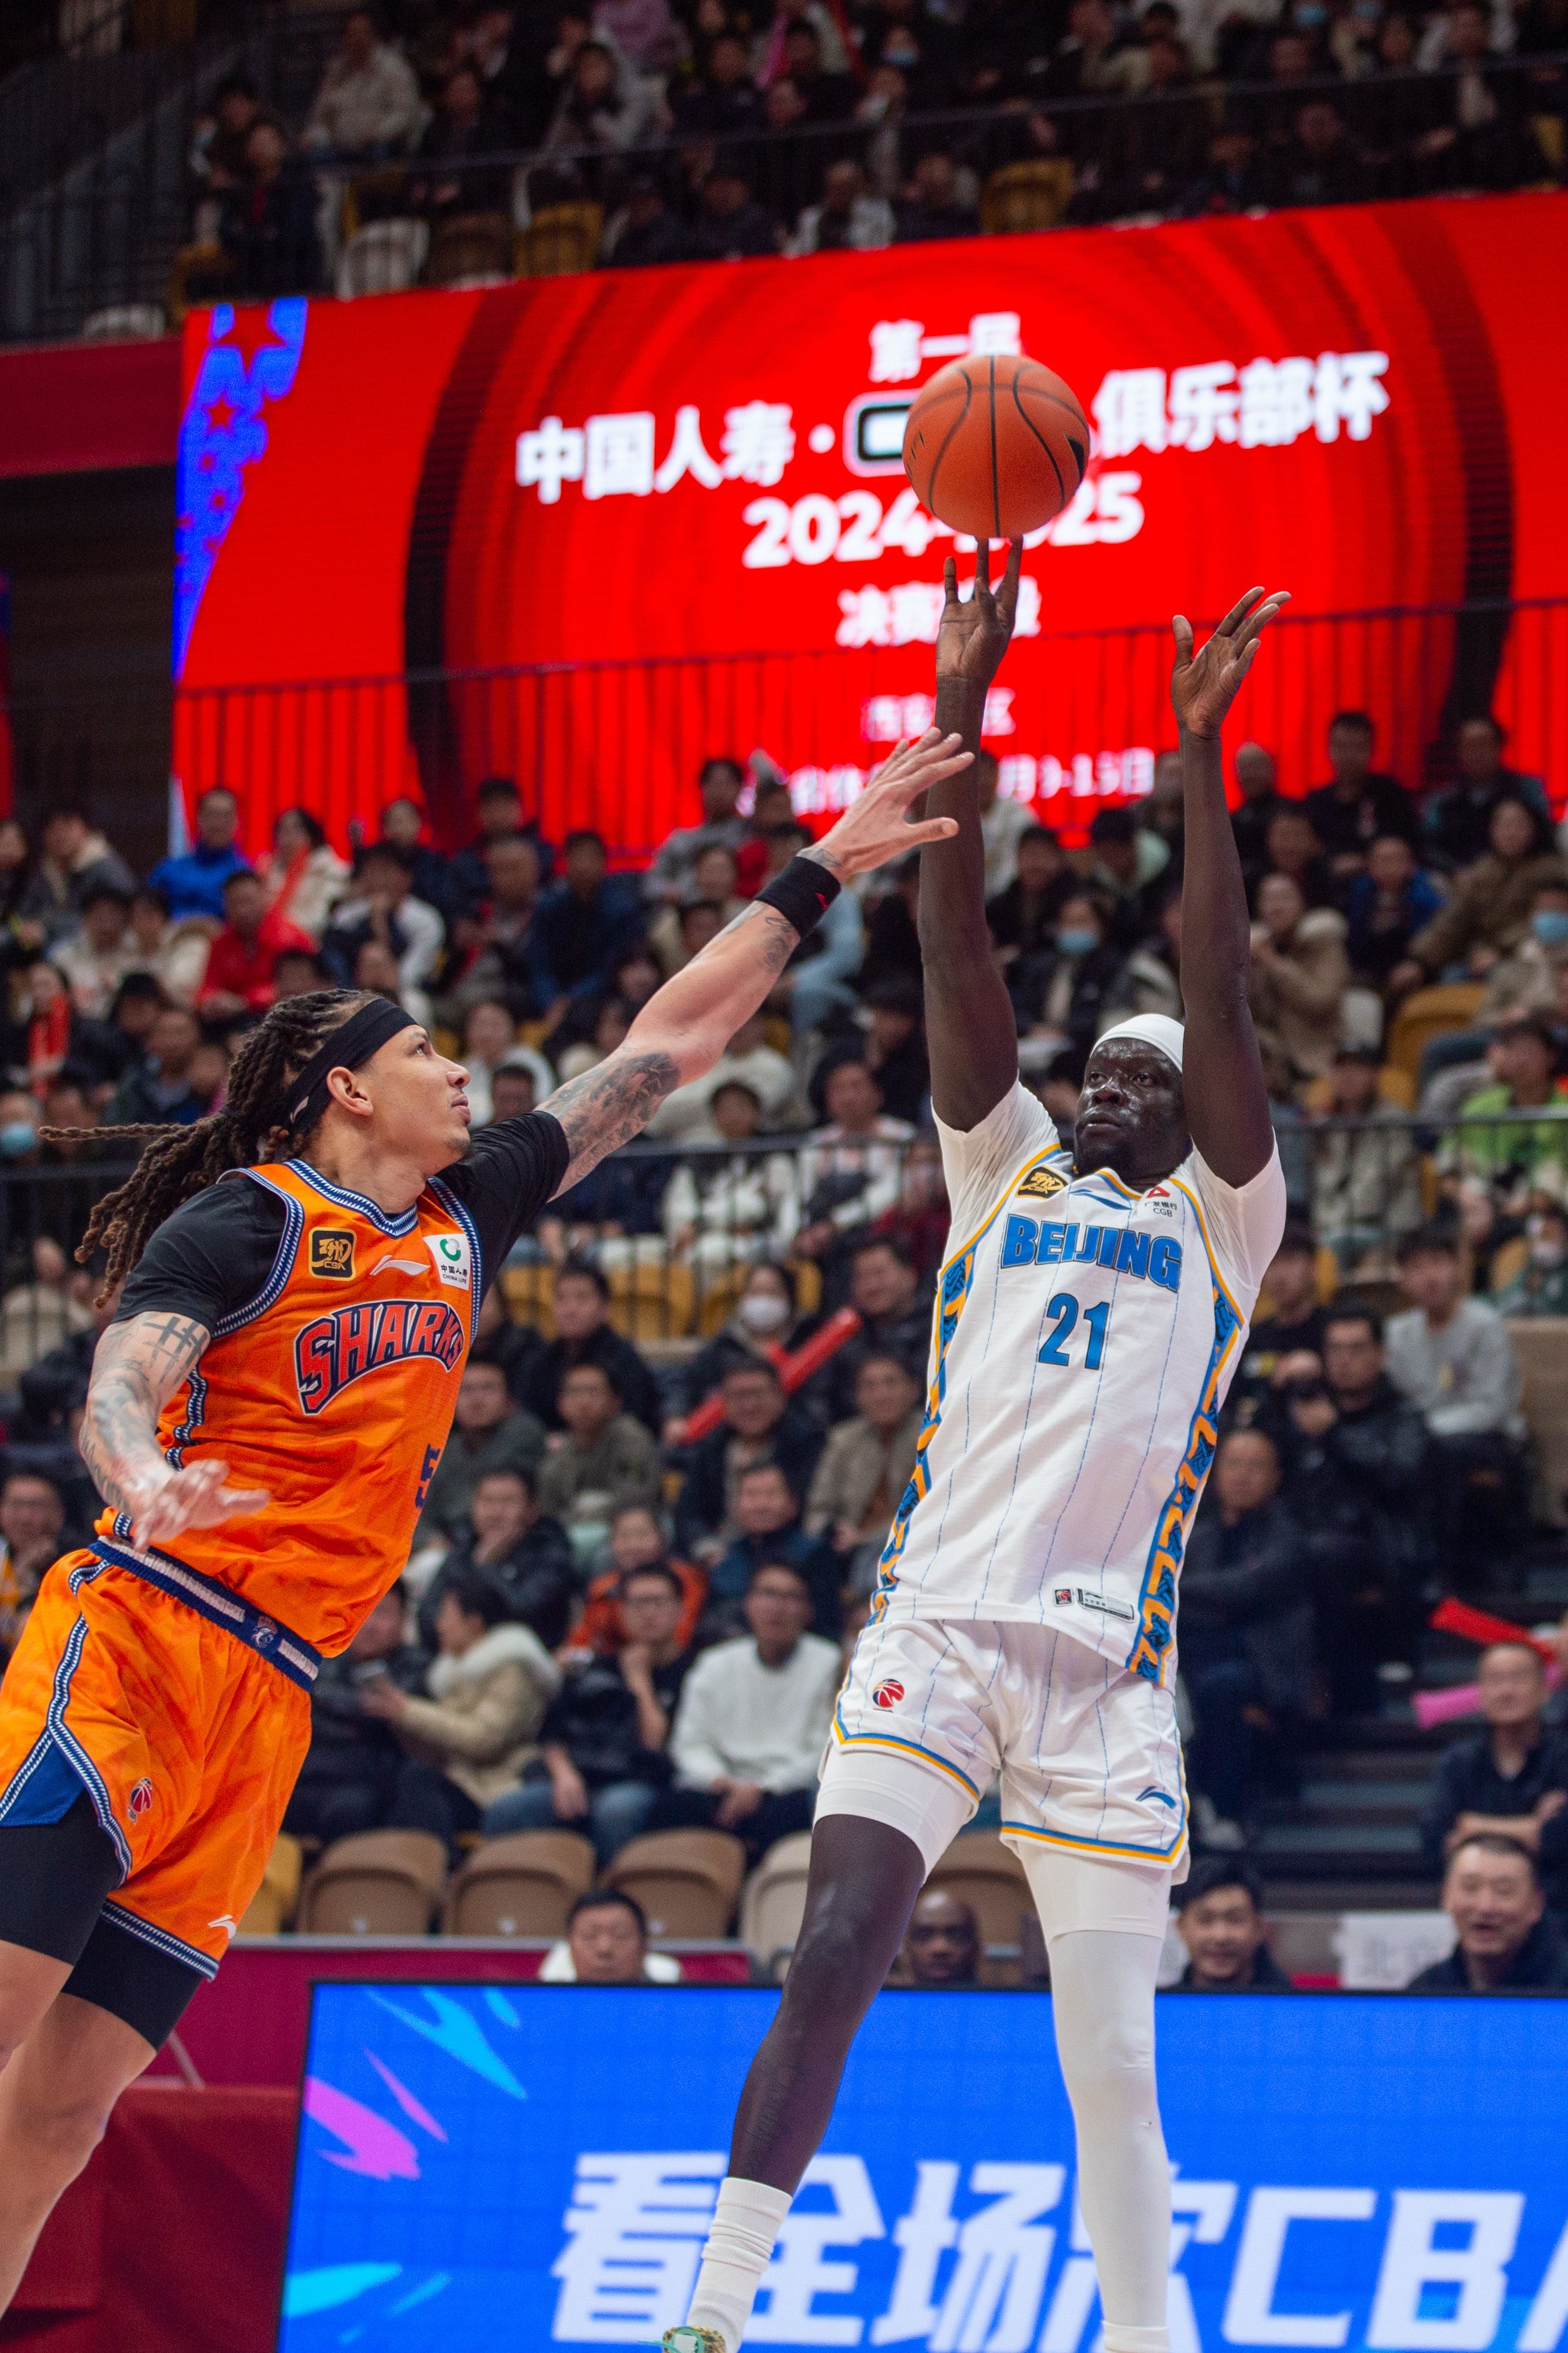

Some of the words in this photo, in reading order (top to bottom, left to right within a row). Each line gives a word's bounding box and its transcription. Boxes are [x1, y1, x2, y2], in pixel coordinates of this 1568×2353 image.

[742, 471, 1145, 570] 2024-25
[1153, 1208, 1173, 1217] CGB
[441, 1264, 468, 1278] 中国人寿
[1001, 1213, 1184, 1293] BEIJING
[293, 1299, 464, 1416] SHARKS
[1038, 1293, 1110, 1371] 21
